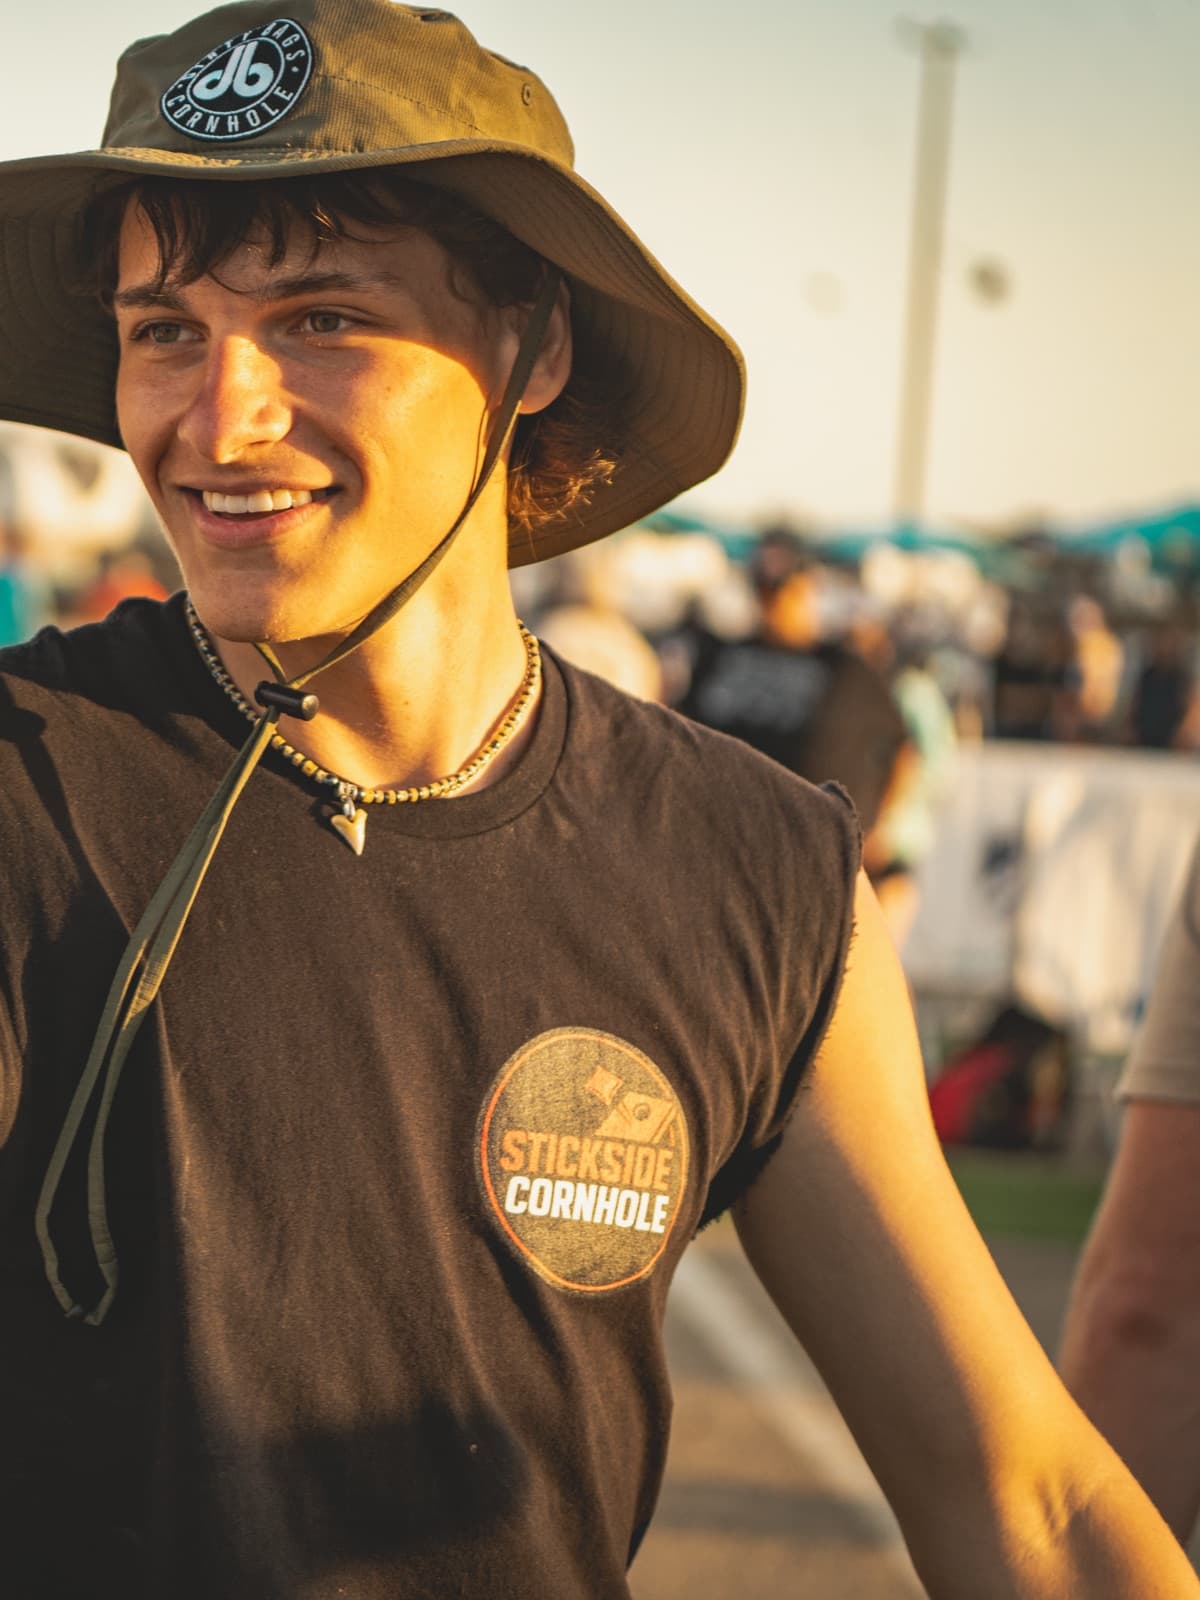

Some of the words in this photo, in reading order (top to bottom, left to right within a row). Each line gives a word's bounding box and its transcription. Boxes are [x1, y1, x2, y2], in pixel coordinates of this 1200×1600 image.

[261, 22, 306, 61] BAGS
[167, 86, 294, 133] CORNHOLE
[500, 1129, 675, 1191] STICKSIDE
[505, 1176, 670, 1234] CORNHOLE
